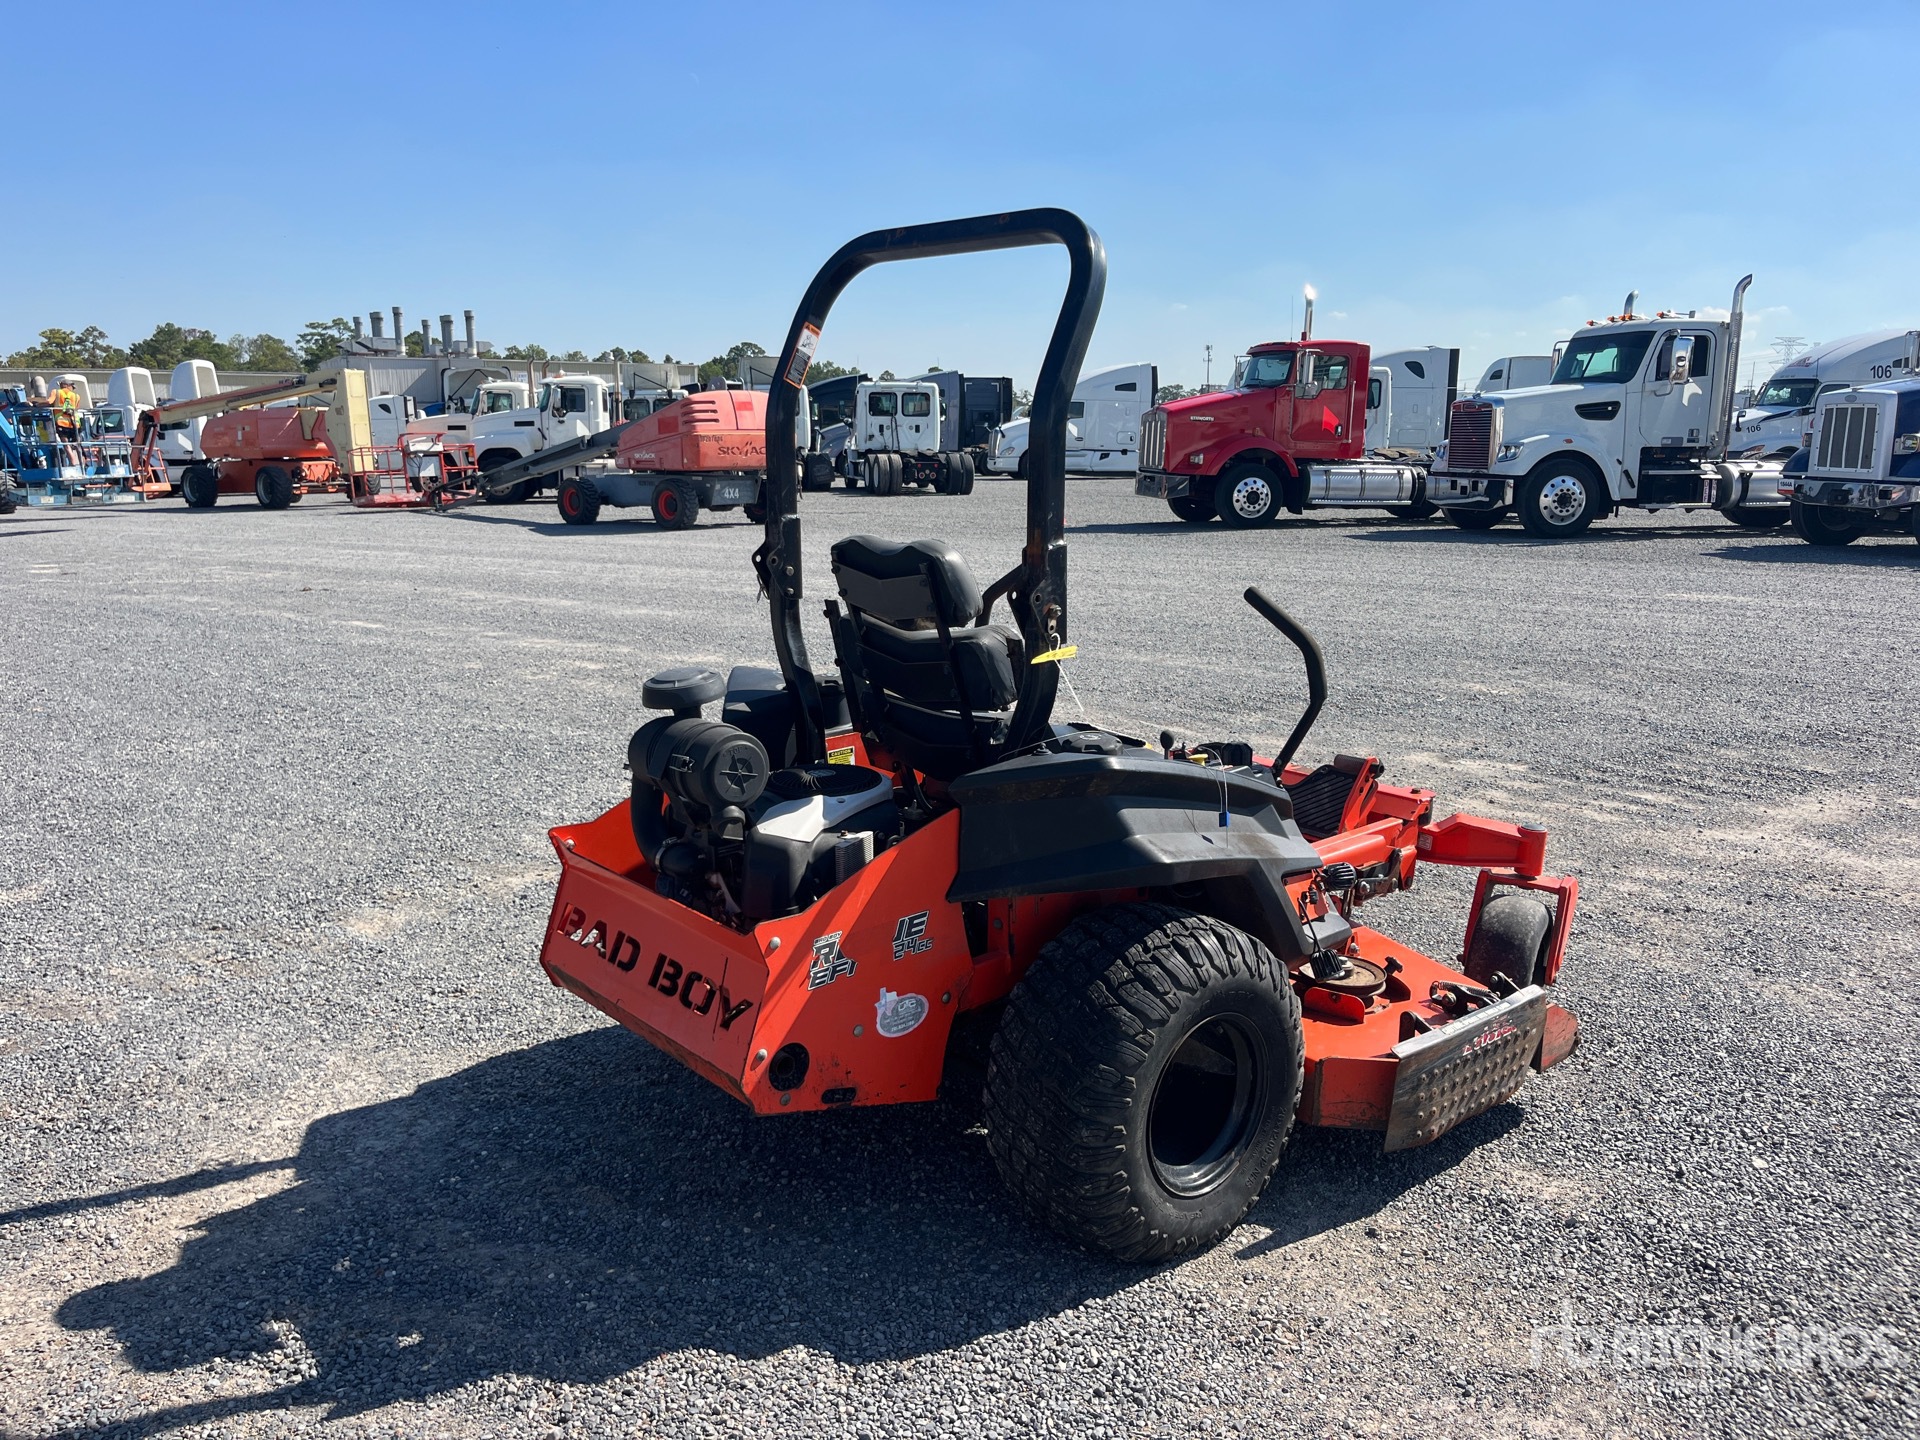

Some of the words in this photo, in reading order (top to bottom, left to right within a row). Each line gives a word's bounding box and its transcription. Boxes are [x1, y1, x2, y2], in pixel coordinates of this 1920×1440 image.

[1870, 365, 1892, 379] 106
[1746, 425, 1761, 433] 106
[717, 441, 767, 457] SKYJAC
[724, 487, 740, 499] 4X4
[556, 902, 641, 974] BAD
[649, 953, 754, 1030] BOY
[808, 959, 858, 990] EFI
